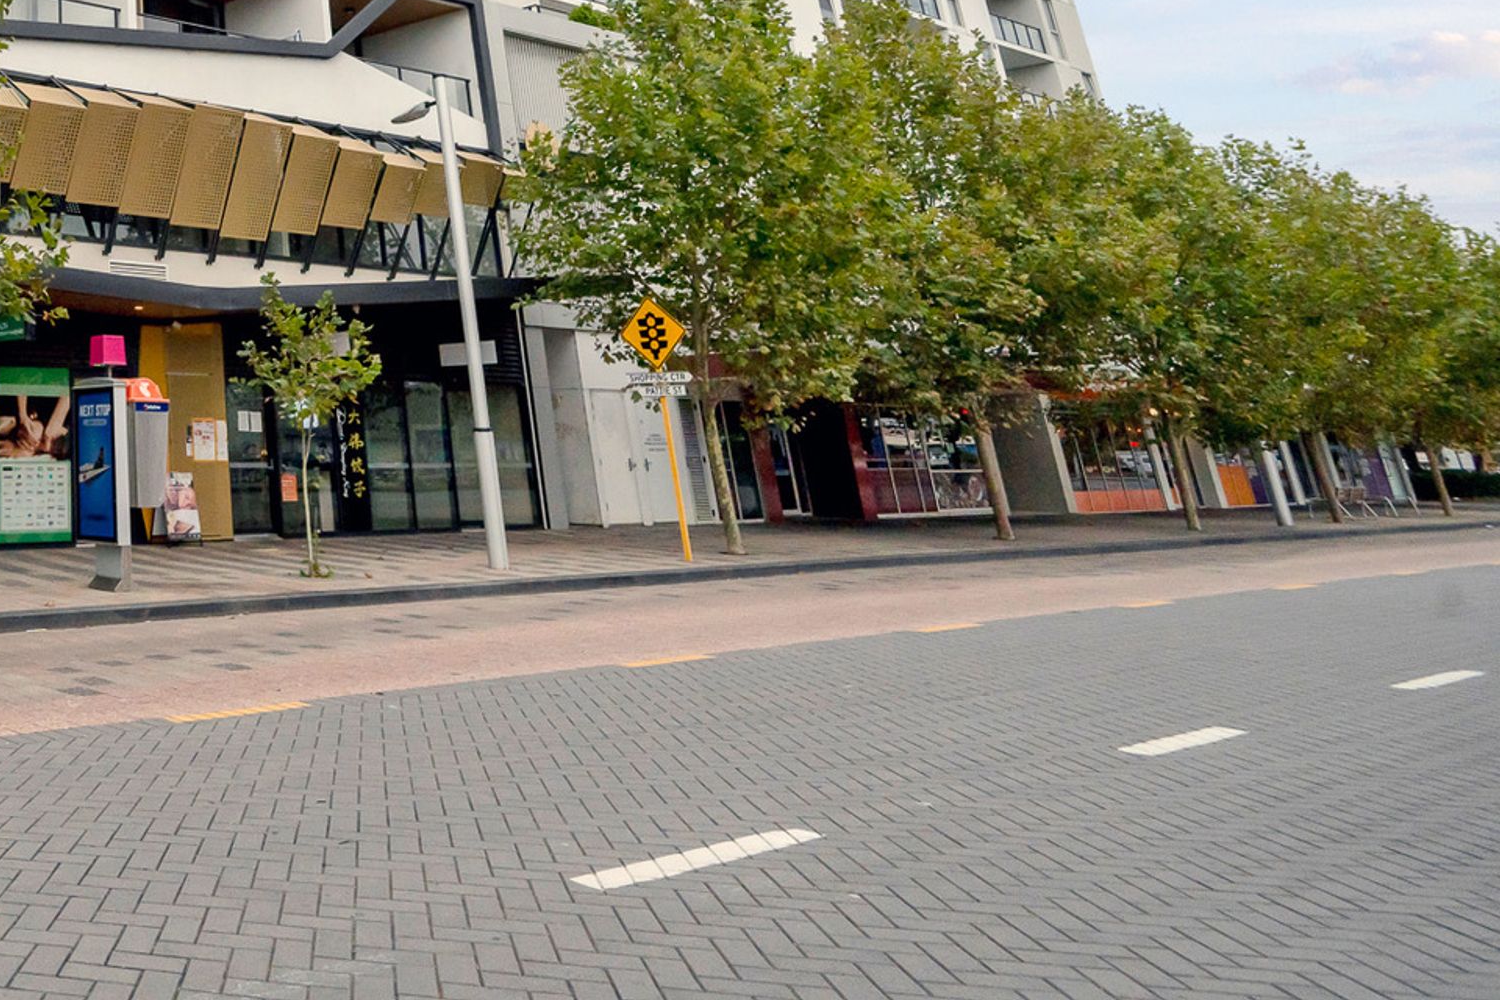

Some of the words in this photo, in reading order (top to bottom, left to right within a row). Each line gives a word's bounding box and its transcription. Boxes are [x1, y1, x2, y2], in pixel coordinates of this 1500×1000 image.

[629, 373, 668, 382] SHOPPING
[670, 373, 686, 381] CTR
[95, 404, 112, 417] STOP
